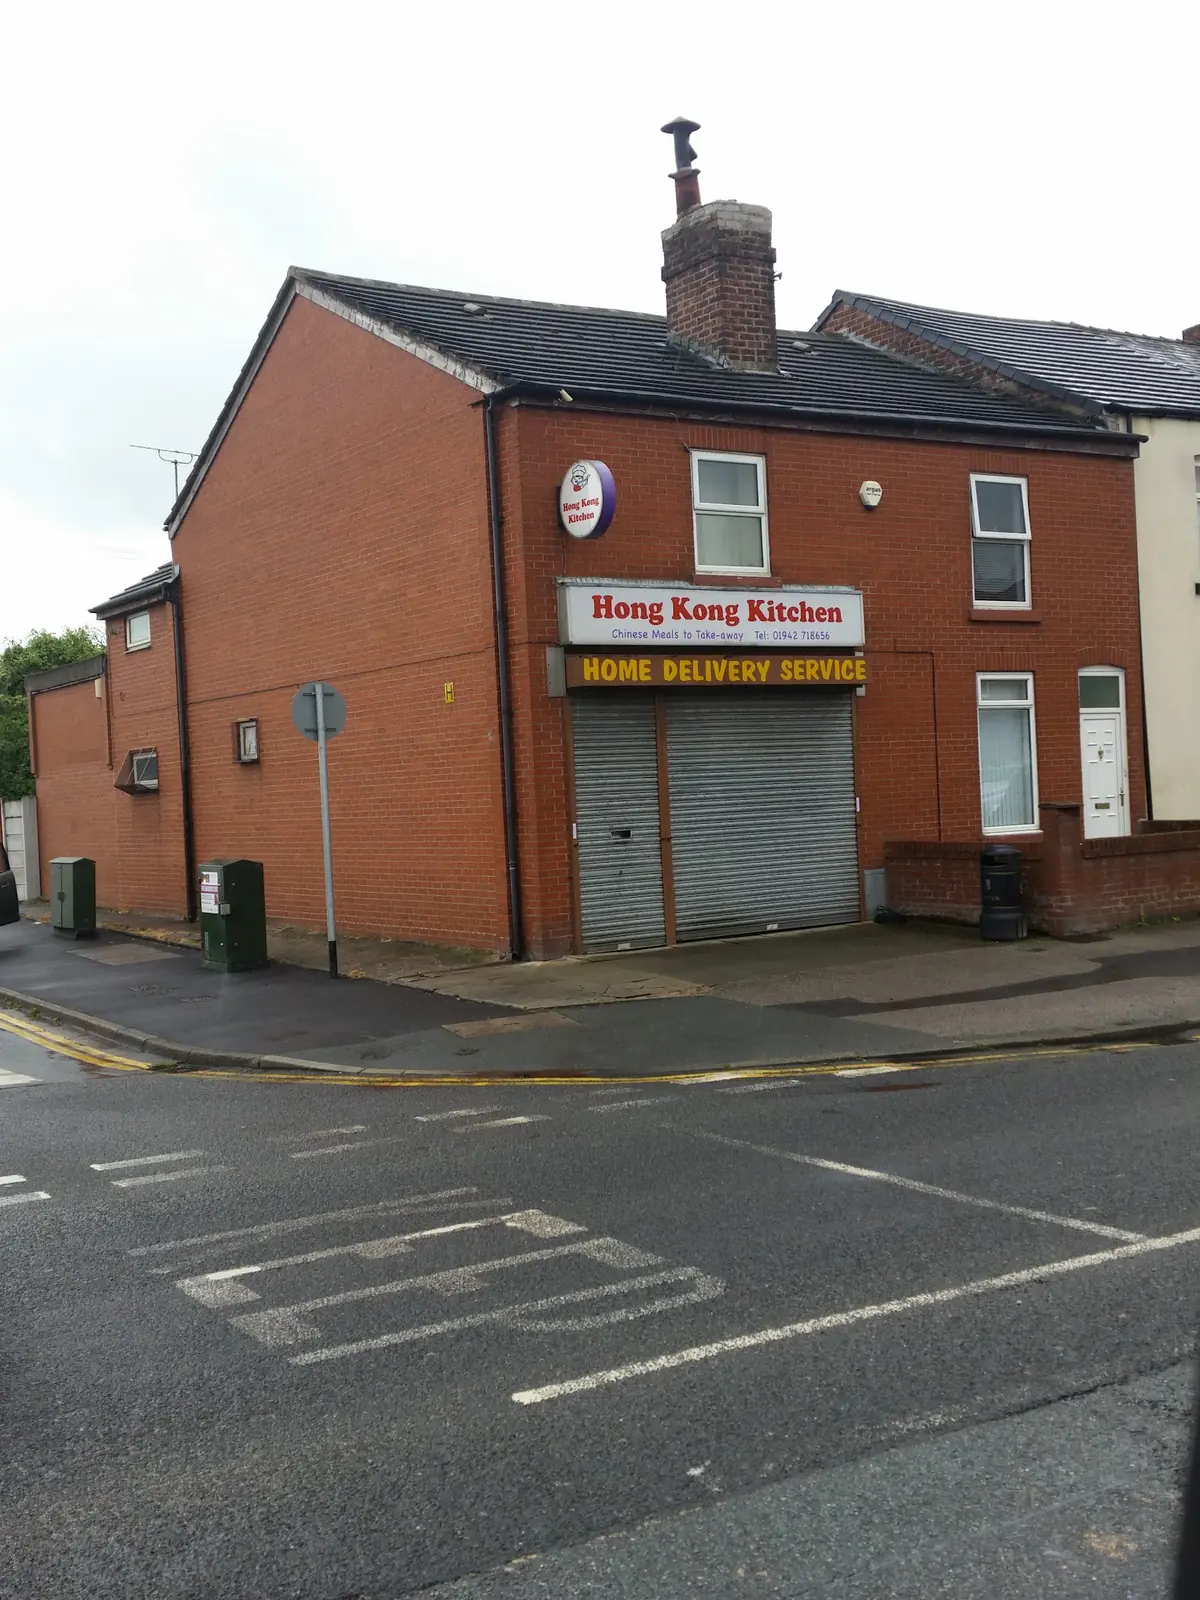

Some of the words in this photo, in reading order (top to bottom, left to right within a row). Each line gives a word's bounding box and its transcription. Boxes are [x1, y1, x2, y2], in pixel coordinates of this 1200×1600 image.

[563, 502, 580, 512] Hong
[581, 497, 599, 507] Kong
[568, 512, 594, 523] Kitchen
[591, 595, 664, 625] Hong
[670, 597, 740, 626] Kong
[746, 599, 843, 622] Kitchen
[611, 628, 648, 639] Chinese
[651, 629, 679, 639] Meals
[683, 630, 692, 639] to
[695, 630, 744, 641] Take-away
[754, 630, 769, 640] Tel:
[772, 631, 798, 640] 01942
[801, 631, 830, 640] 718656
[583, 657, 652, 681] HOME
[663, 658, 771, 682] DELIVERY
[779, 658, 867, 681] SERVICE
